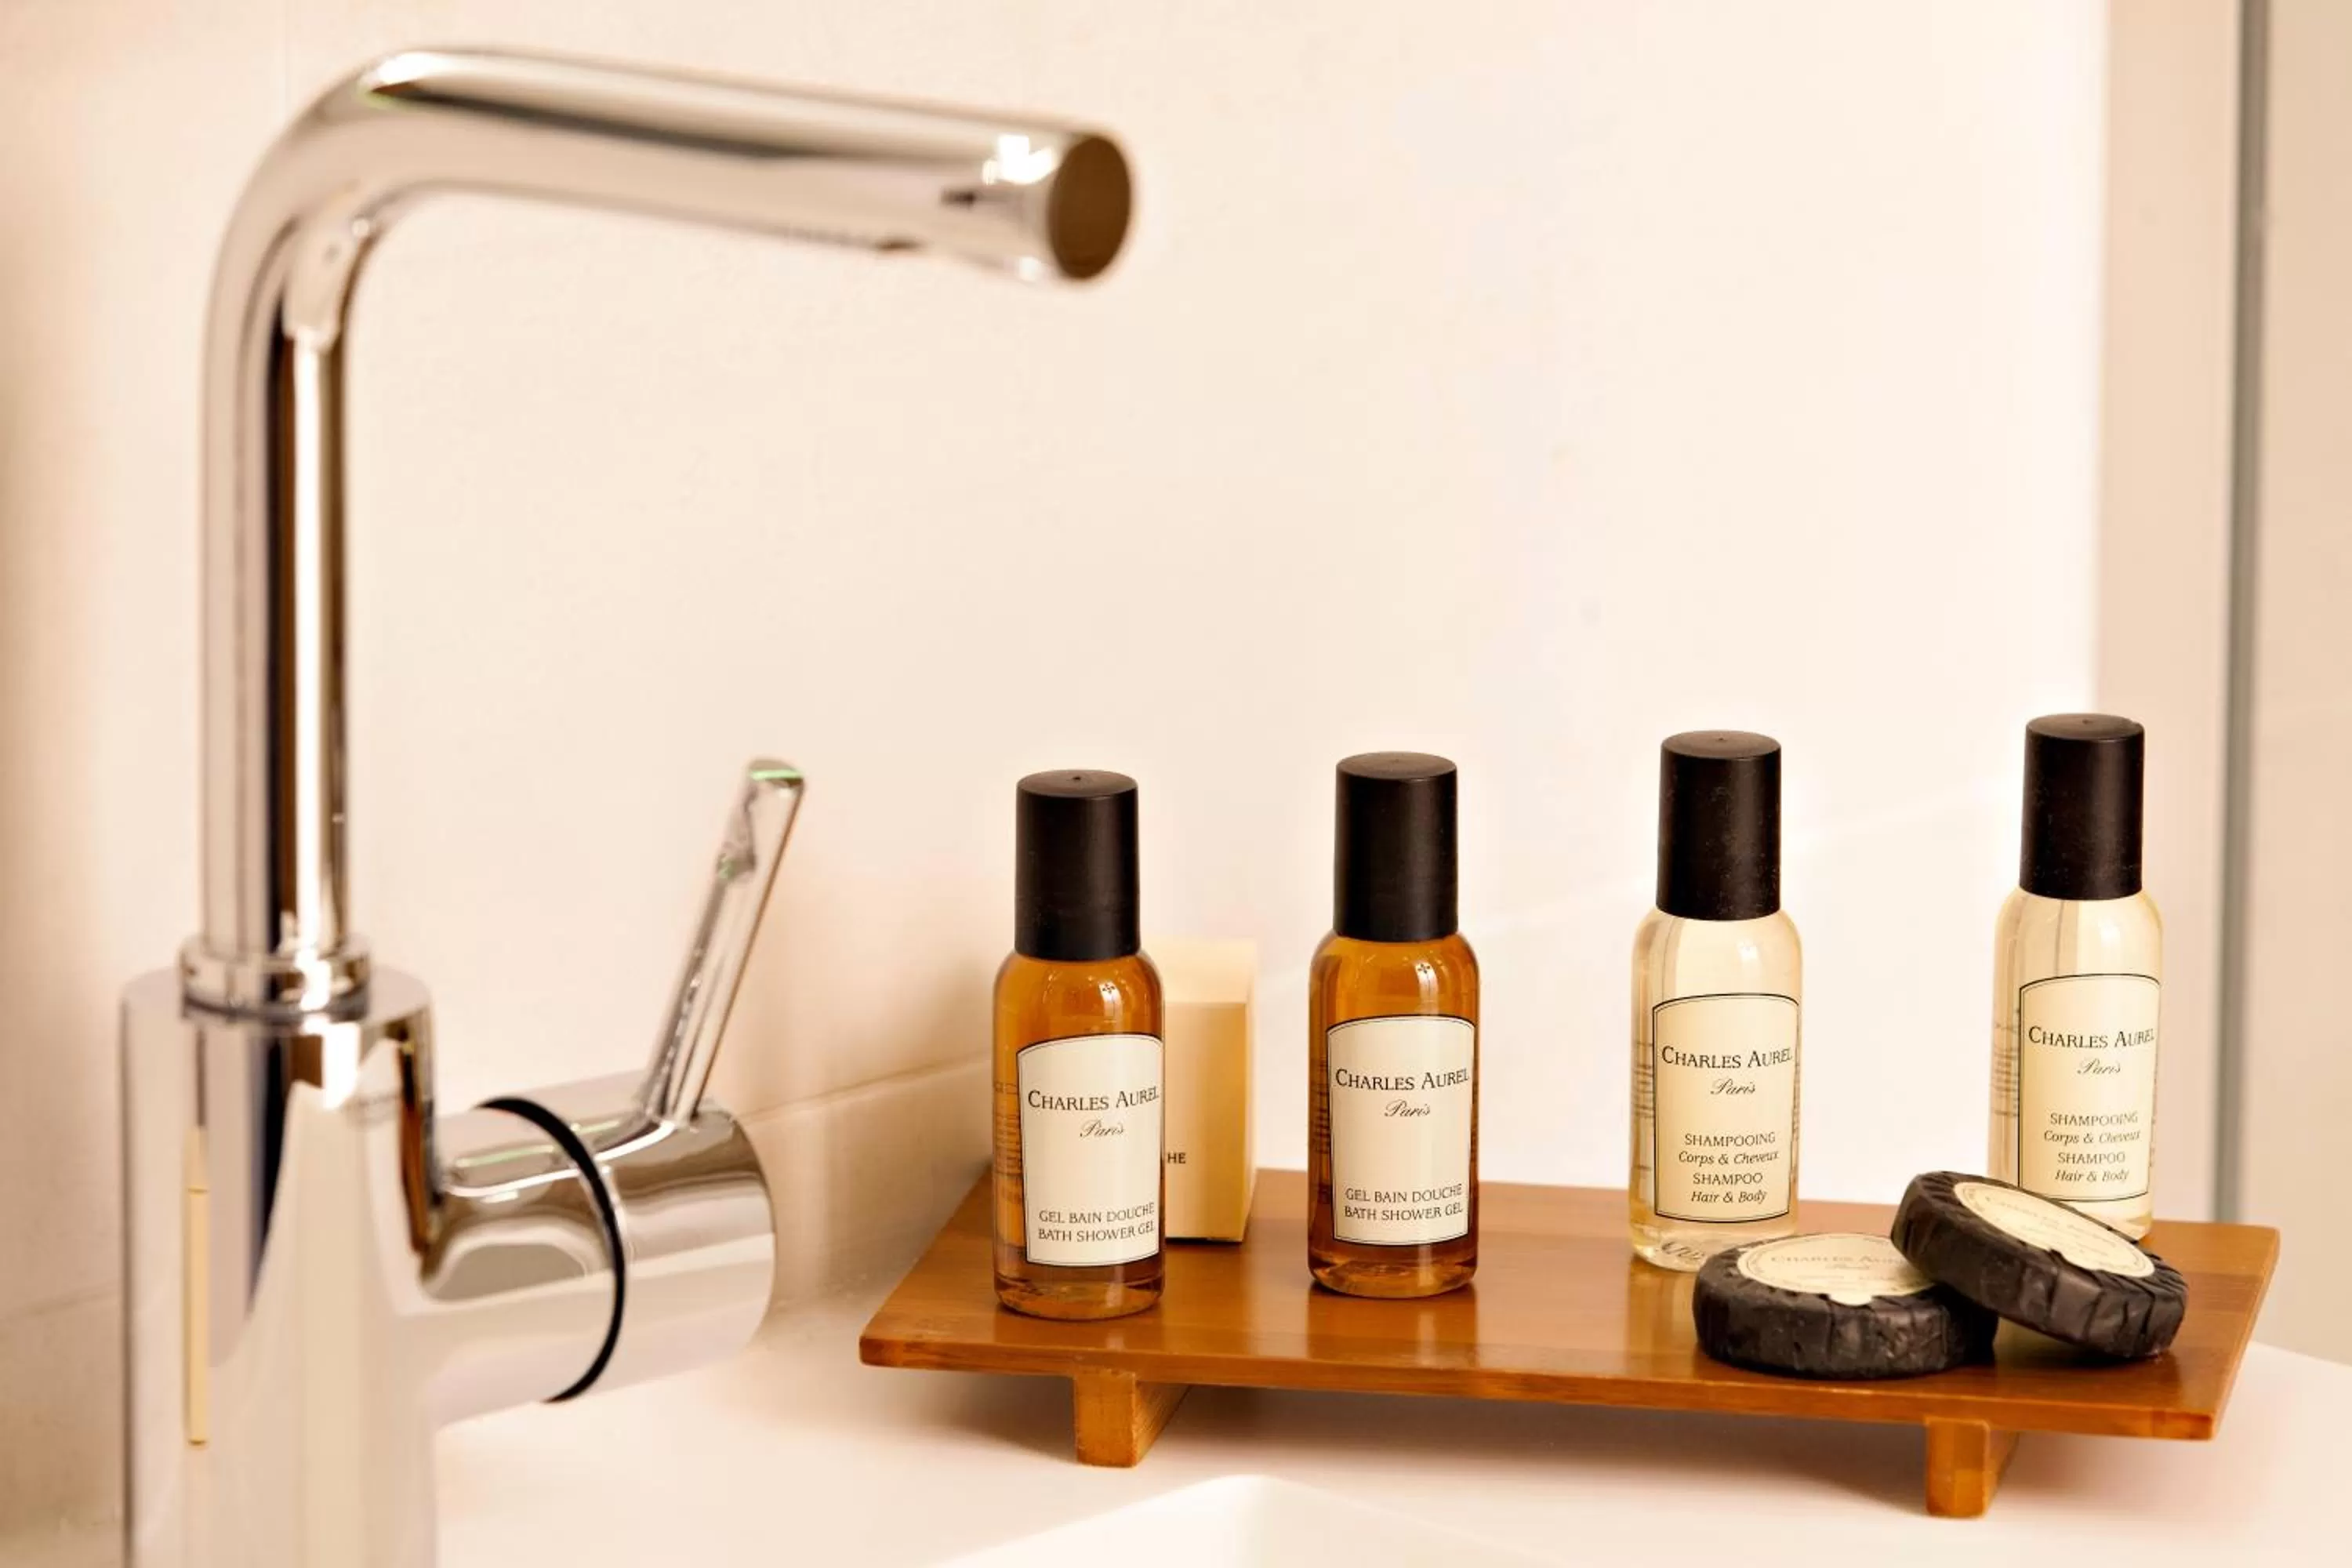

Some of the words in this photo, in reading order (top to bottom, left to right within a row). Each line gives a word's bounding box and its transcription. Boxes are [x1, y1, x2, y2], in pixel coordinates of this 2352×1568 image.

[2028, 1025, 2108, 1048] CHARLES
[2114, 1027, 2154, 1047] AUREL
[1661, 1045, 1741, 1068] CHARLES
[1748, 1047, 1792, 1068] AUREL
[2077, 1058, 2121, 1075] Paris
[1336, 1069, 1415, 1090] CHARLES
[1421, 1068, 1470, 1091] AUREL
[1711, 1078, 1755, 1095] Paris
[1028, 1090, 1109, 1110] CHARLES
[1116, 1086, 1159, 1108] AUREL
[1384, 1099, 1431, 1117] Paris
[2050, 1111, 2138, 1127] SHAMPOOING
[1080, 1120, 1124, 1138] Paris
[2044, 1130, 2079, 1146] Corps
[2083, 1132, 2093, 1143] &
[1684, 1131, 1776, 1147] SHAMPOOING
[1679, 1149, 1714, 1167] Corps
[1719, 1152, 1729, 1165] &
[1734, 1150, 1779, 1164] Cheveux
[2057, 1152, 2125, 1164] SHAMPOO
[1693, 1173, 1762, 1185] SHAMPOO
[2055, 1169, 2083, 1181] Hair
[2086, 1171, 2096, 1182] &
[1345, 1187, 1370, 1202] GEL
[1374, 1191, 1407, 1203] BAIN
[1413, 1184, 1462, 1203] DOUCHE
[1691, 1192, 1719, 1203] Hair
[1722, 1191, 1733, 1203] &
[1738, 1190, 1767, 1204] Body
[1039, 1210, 1065, 1224] GEL
[1069, 1211, 1102, 1224] BAIN
[1106, 1202, 1155, 1223] DOUCHE
[1344, 1205, 1377, 1220] BATH
[1381, 1207, 1442, 1221] SHOWER
[1446, 1202, 1463, 1216] GEL
[1038, 1228, 1072, 1242] BATH
[1076, 1228, 1136, 1243] SHOWER
[1138, 1220, 1155, 1236] GEL
